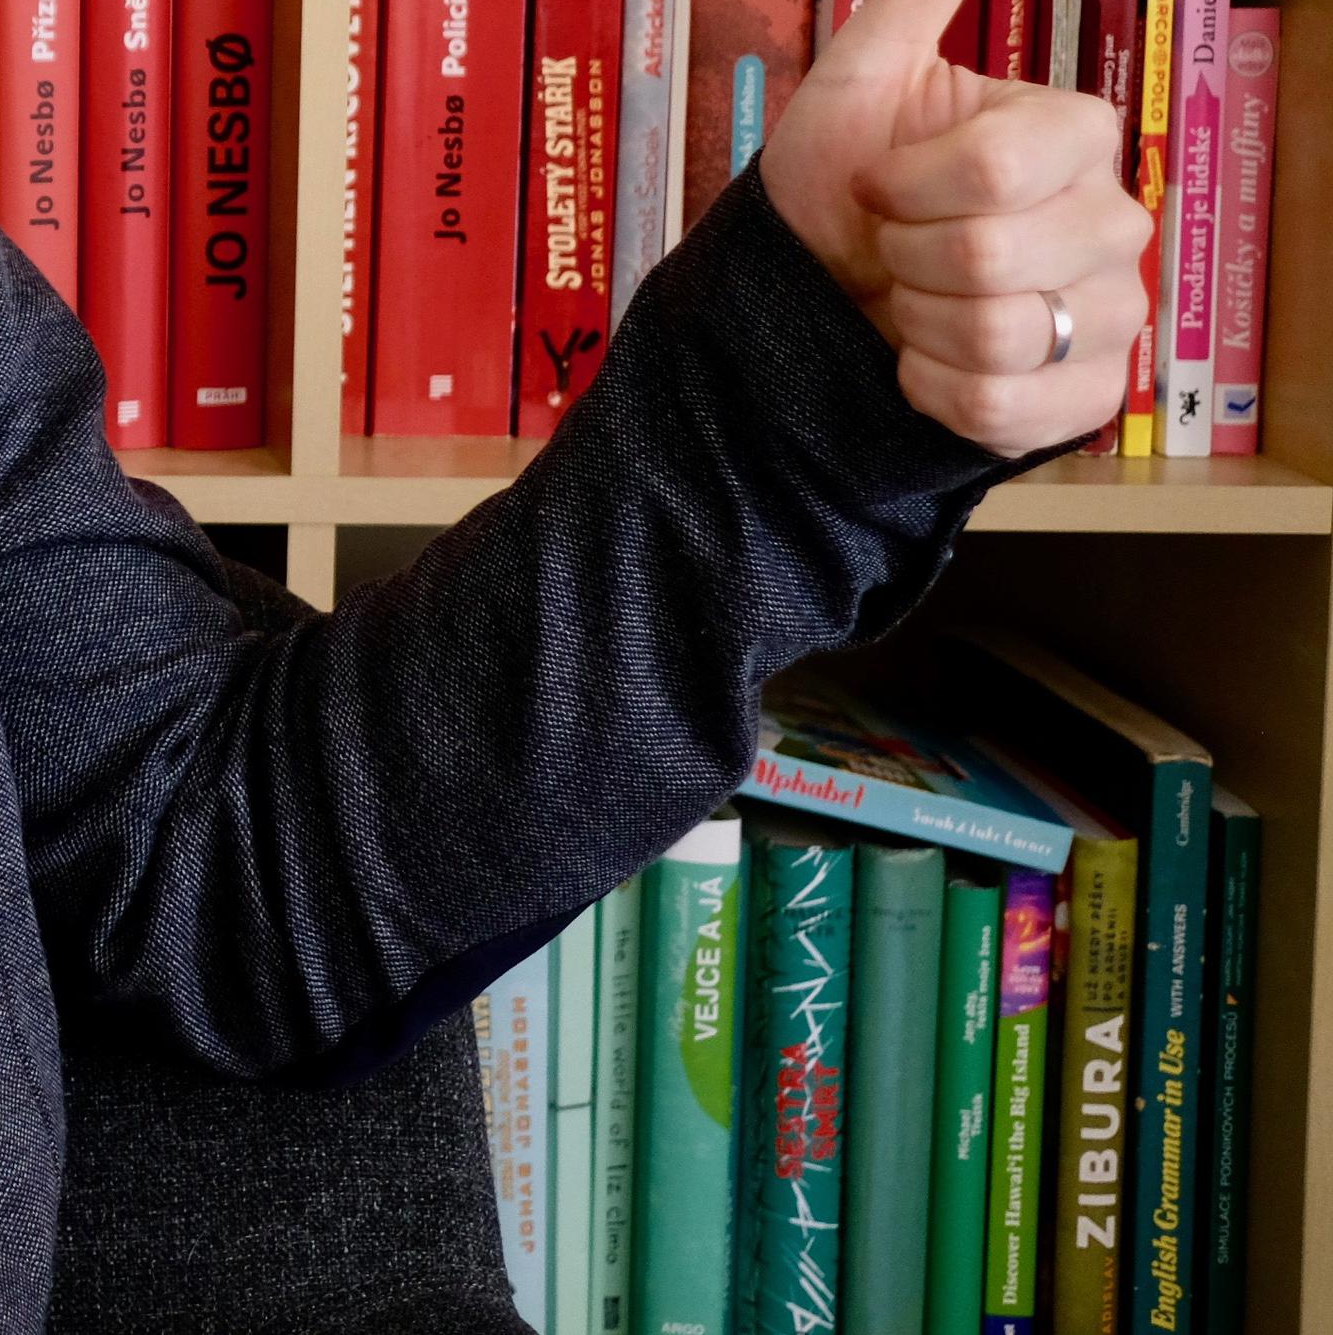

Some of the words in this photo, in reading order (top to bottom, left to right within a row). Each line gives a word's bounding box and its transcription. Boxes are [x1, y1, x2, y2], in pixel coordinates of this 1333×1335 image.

[28, 79, 56, 185] Nesbø
[121, 67, 147, 173] Nesbø
[205, 32, 254, 217] NESBØ
[436, 94, 465, 203] Nesbø
[589, 59, 605, 199] JONASSON
[1184, 126, 1212, 190] lidské
[28, 195, 60, 230] Jo
[119, 182, 152, 218] Jo
[435, 209, 467, 244] Jo
[1187, 194, 1215, 223] je
[204, 231, 249, 302] JO
[590, 201, 605, 295] JONAS
[1179, 225, 1209, 330] Prodávat
[698, 919, 722, 940] A
[703, 876, 722, 913] JÁ
[1173, 903, 1188, 976] ANSWERS
[694, 946, 722, 1042] VEJCE
[1169, 979, 1184, 1019] WITH
[1157, 1077, 1183, 1106] in
[1158, 1029, 1186, 1075] Use
[773, 1041, 809, 1180] SESTRA
[809, 1062, 840, 1160] SMRT
[1076, 1013, 1125, 1249] ZIBURA
[1152, 1107, 1183, 1230] Grammar
[1150, 1233, 1178, 1332] English
